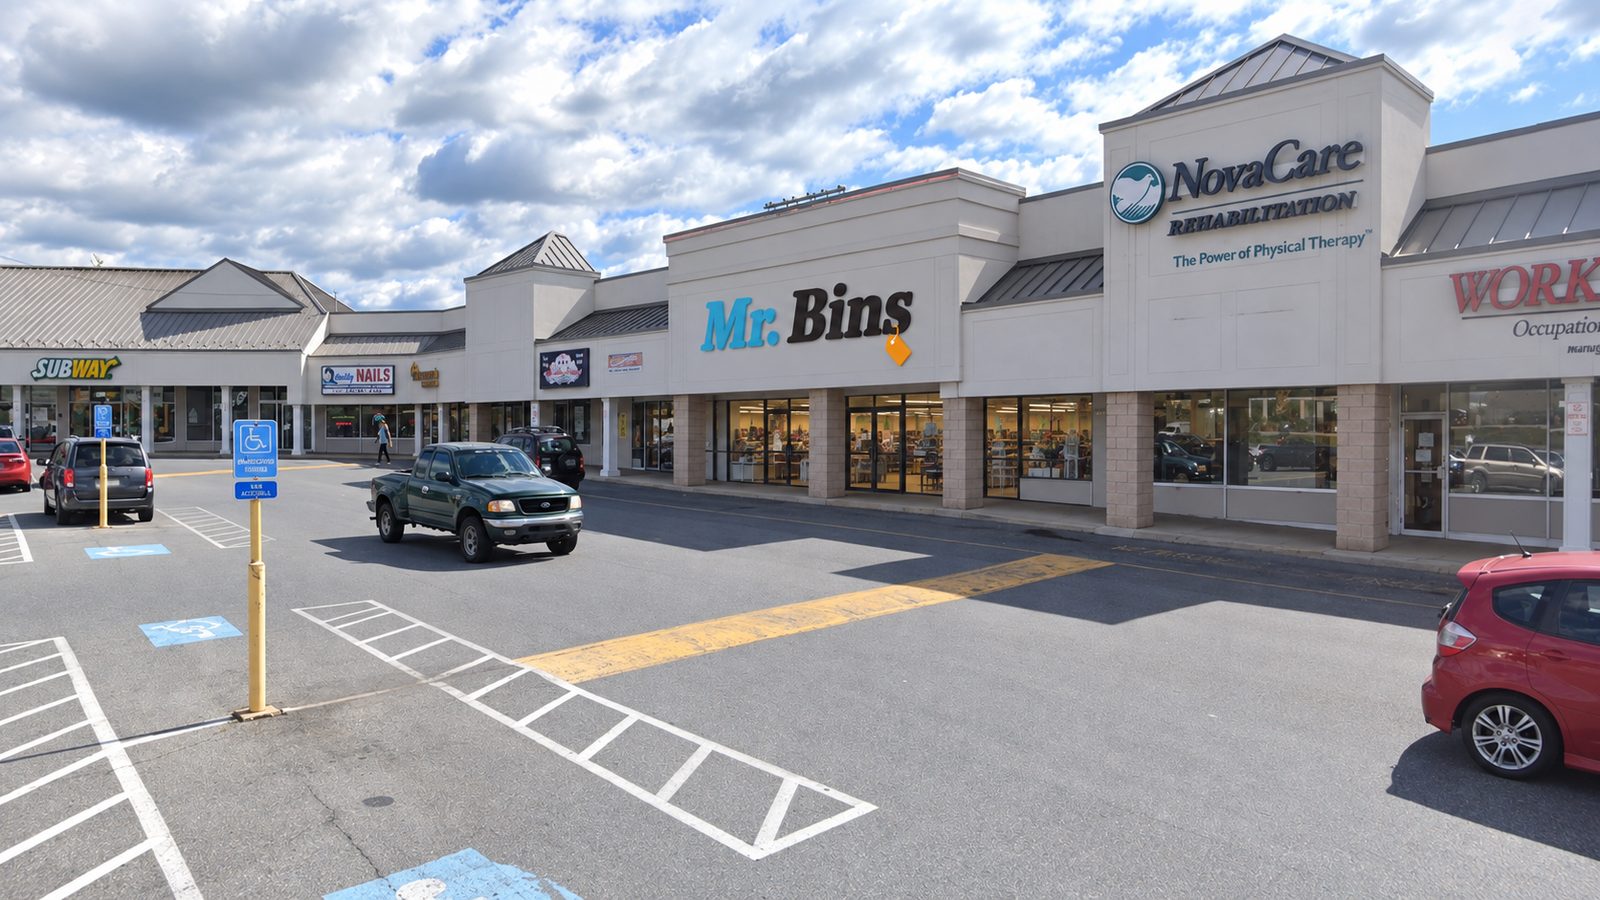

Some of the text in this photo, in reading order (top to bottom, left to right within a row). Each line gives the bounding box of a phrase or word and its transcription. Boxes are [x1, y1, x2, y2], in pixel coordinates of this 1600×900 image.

[1168, 139, 1363, 202] NovaCare
[1167, 191, 1357, 237] REHABILITATION
[1173, 254, 1197, 268] The
[1199, 250, 1237, 265] Power
[1239, 247, 1252, 260] of
[1253, 237, 1306, 260] Physical
[701, 282, 913, 352] Mr. Bins
[31, 356, 121, 380] SUBWAY
[356, 368, 390, 383] NAILS
